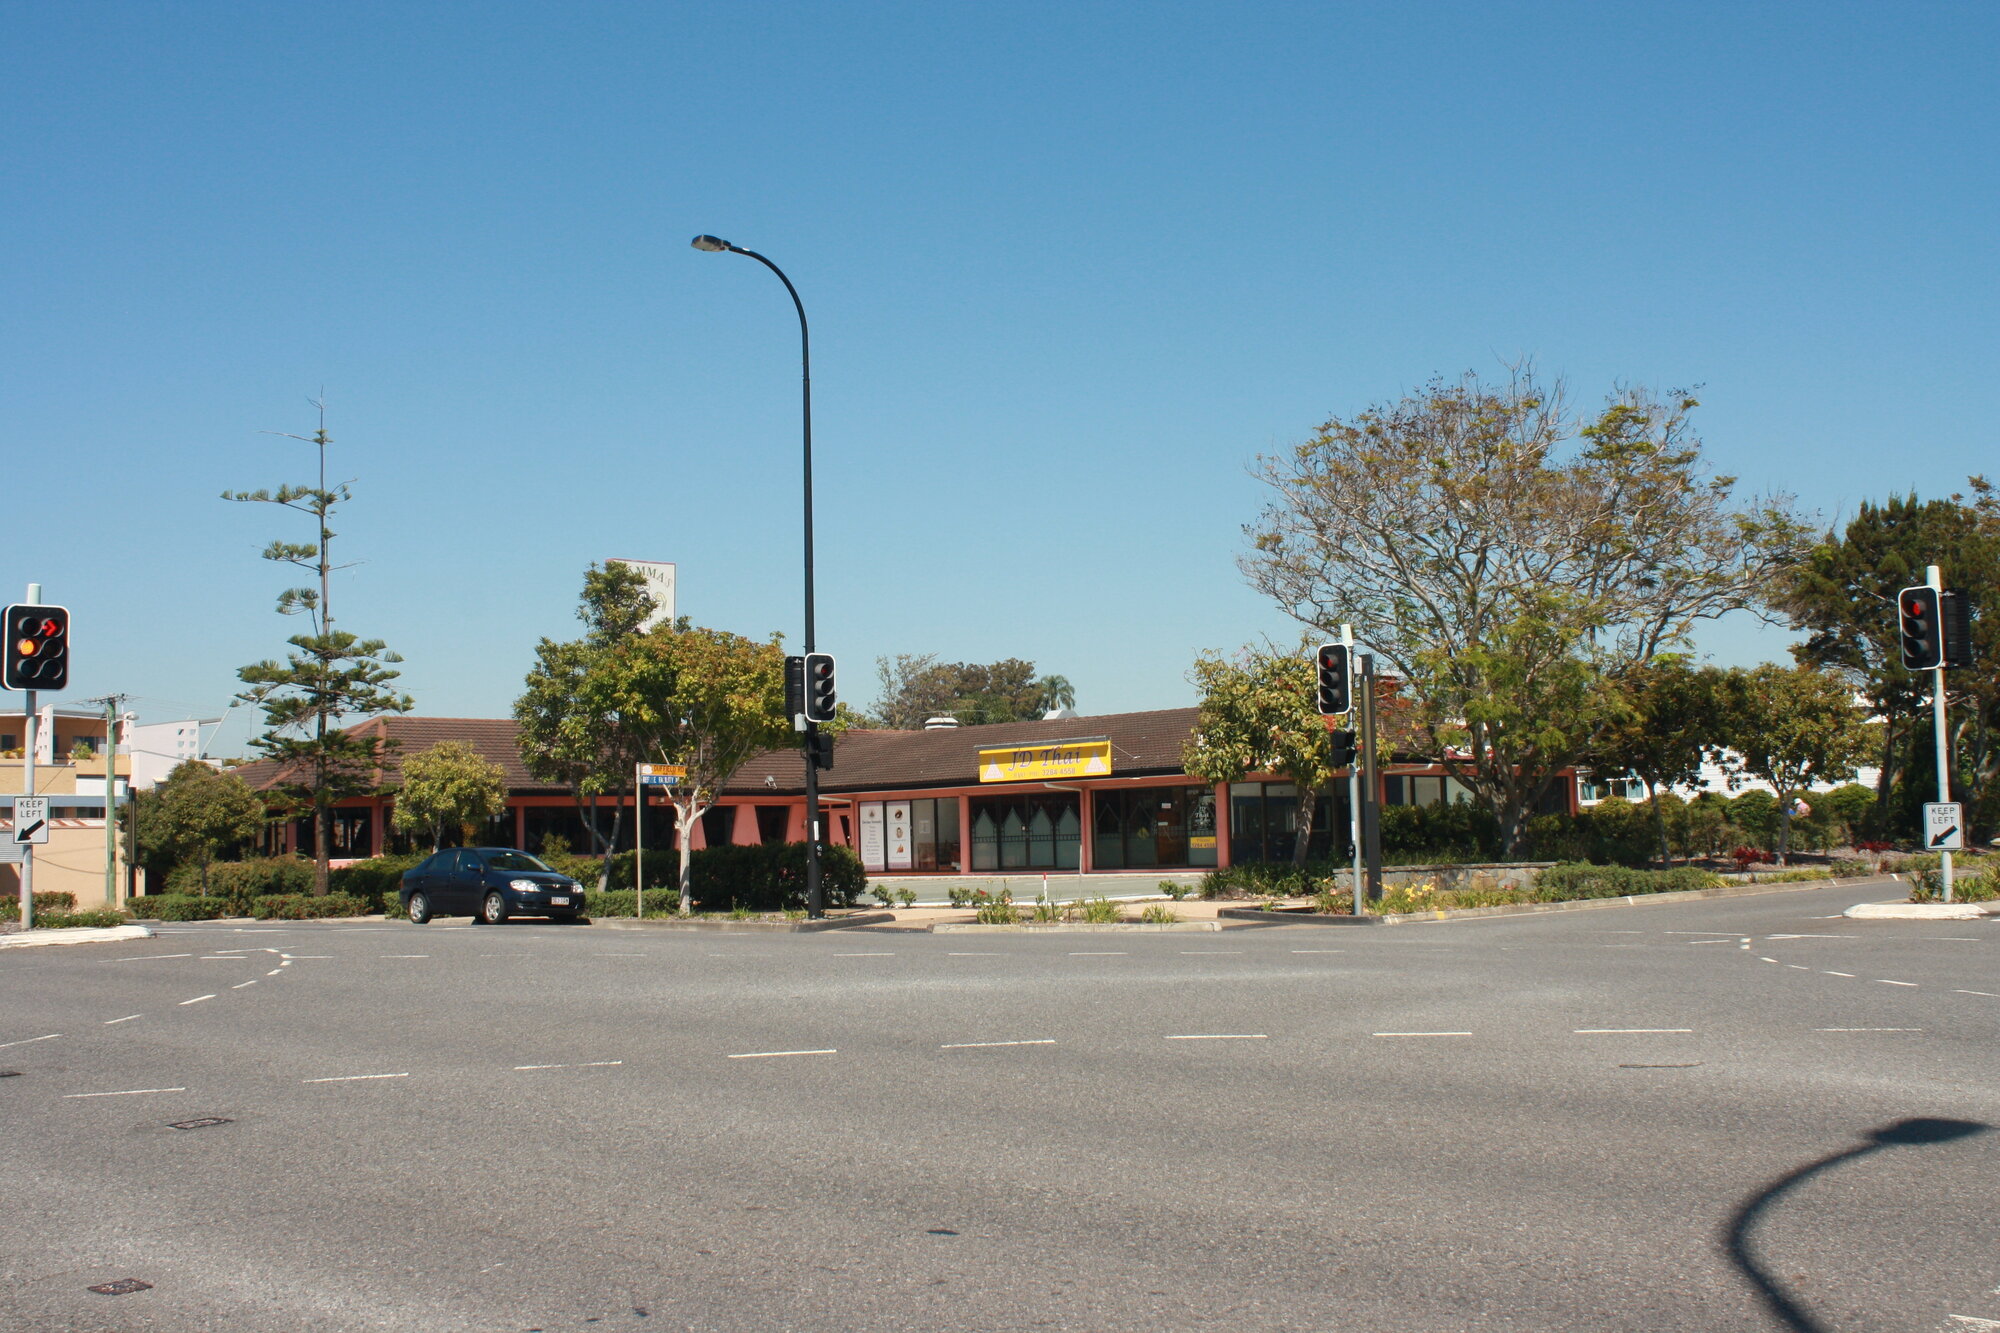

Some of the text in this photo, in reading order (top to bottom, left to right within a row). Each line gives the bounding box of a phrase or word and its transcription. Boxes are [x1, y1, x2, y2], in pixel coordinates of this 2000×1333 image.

[1008, 745, 1081, 771] JD Thai
[20, 800, 43, 808] KEEP
[20, 810, 42, 818] LEFT
